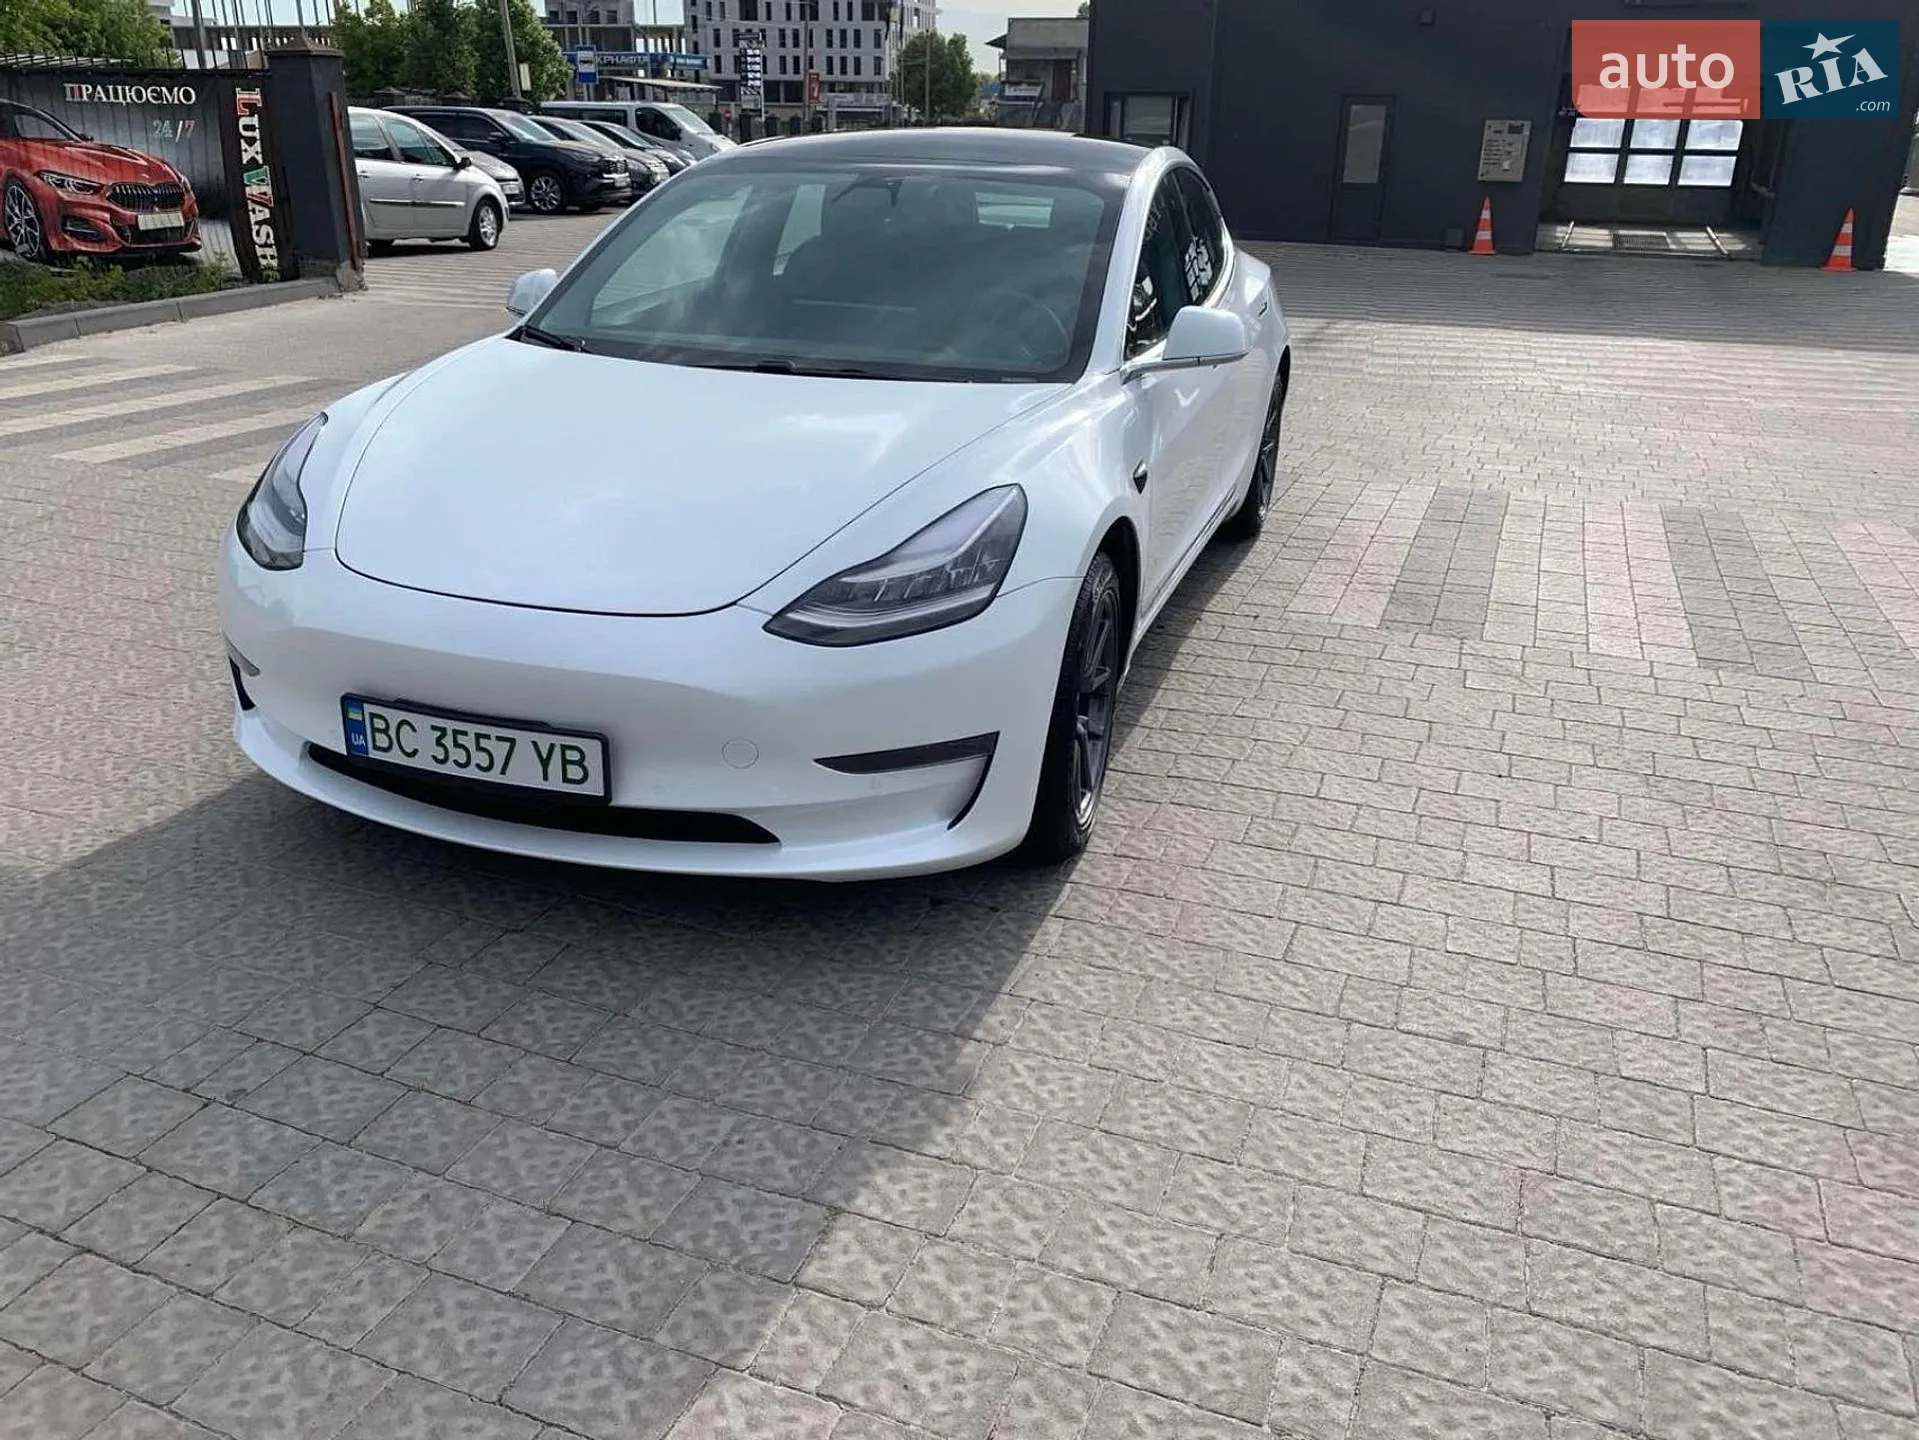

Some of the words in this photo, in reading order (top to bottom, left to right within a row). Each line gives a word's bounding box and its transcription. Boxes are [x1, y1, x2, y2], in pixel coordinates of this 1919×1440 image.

[64, 83, 197, 106] ПРАЦЮЄМО
[153, 119, 196, 143] 24/7
[351, 731, 367, 747] UA
[368, 712, 418, 758] BC
[429, 724, 517, 776] 3557
[531, 740, 590, 785] YB
